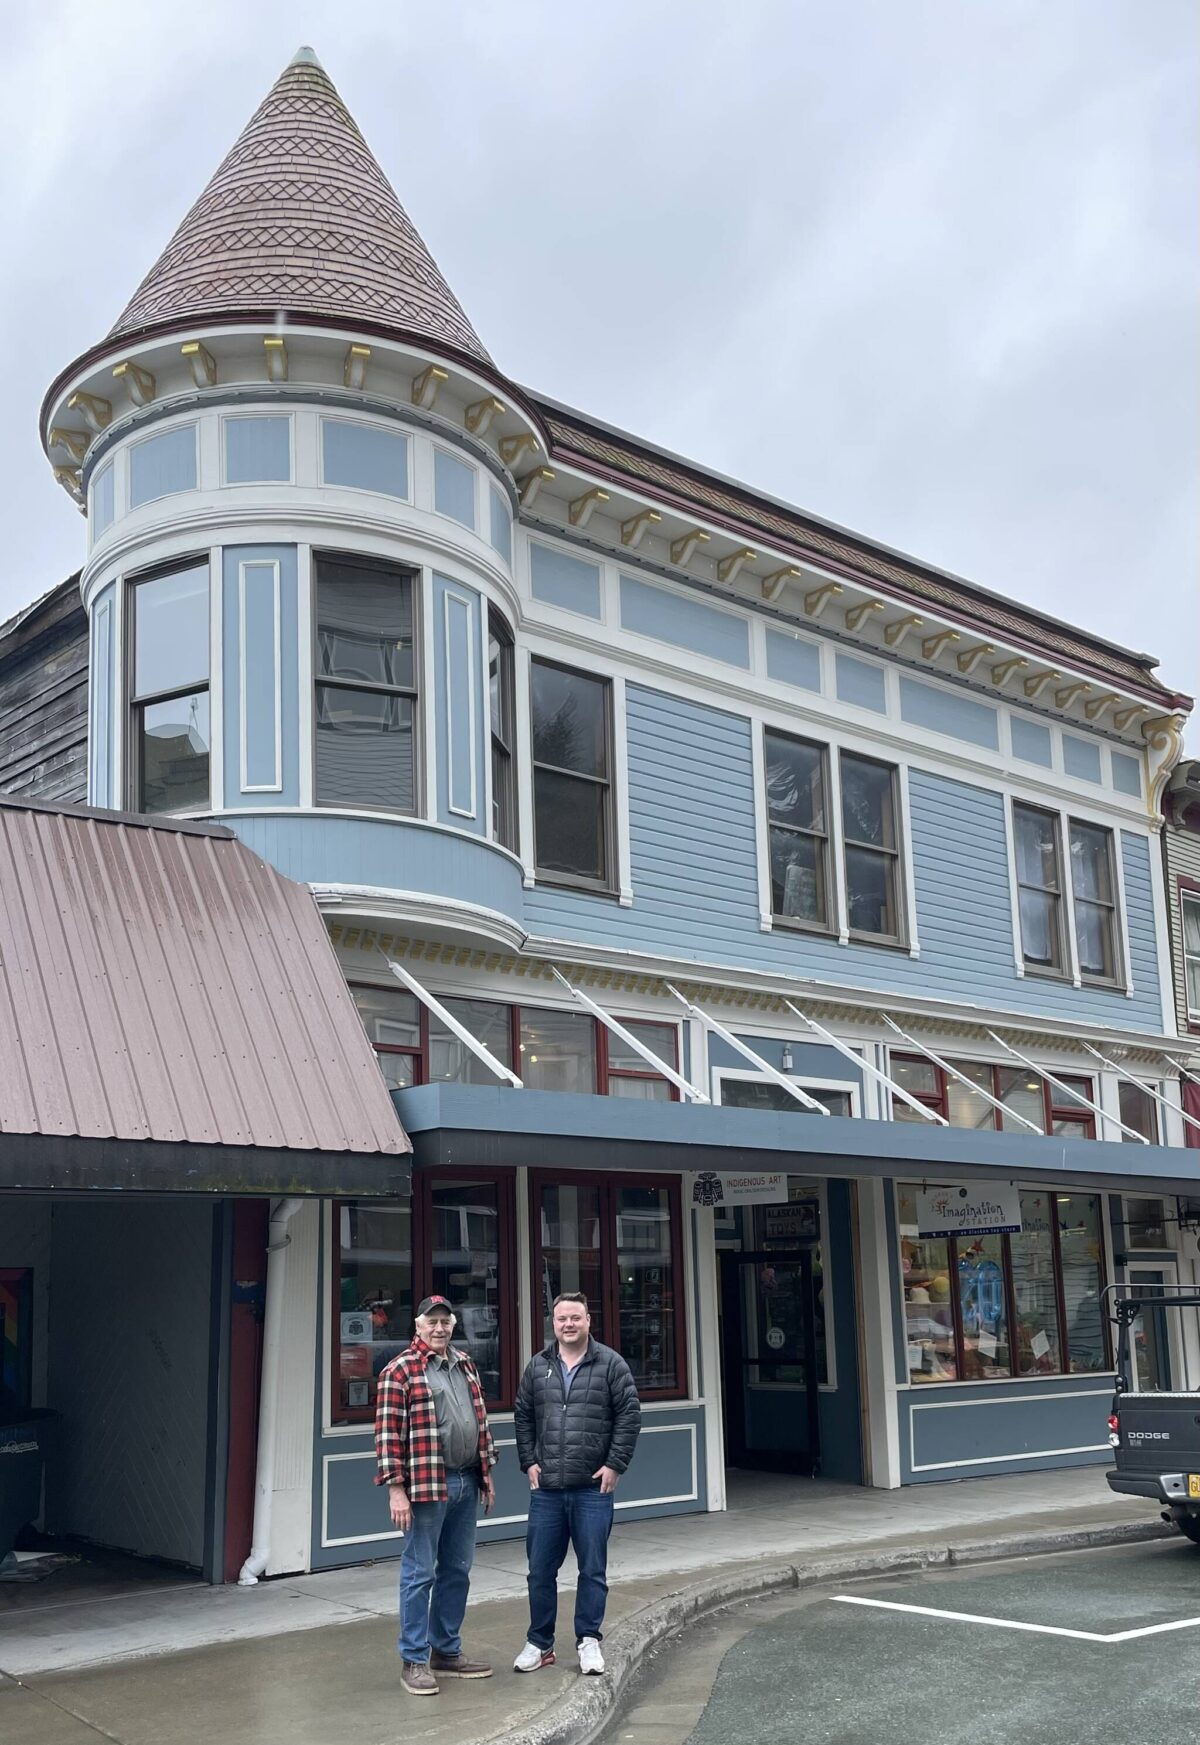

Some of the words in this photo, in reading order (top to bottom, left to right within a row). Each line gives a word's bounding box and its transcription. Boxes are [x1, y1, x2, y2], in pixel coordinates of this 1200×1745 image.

[727, 1176, 766, 1188] INDIGENOUS
[768, 1175, 782, 1185] ART
[768, 1208, 801, 1218] ALASKAN
[942, 1201, 1004, 1226] Imagination
[966, 1216, 1006, 1226] STATION
[768, 1222, 797, 1235] TOYS
